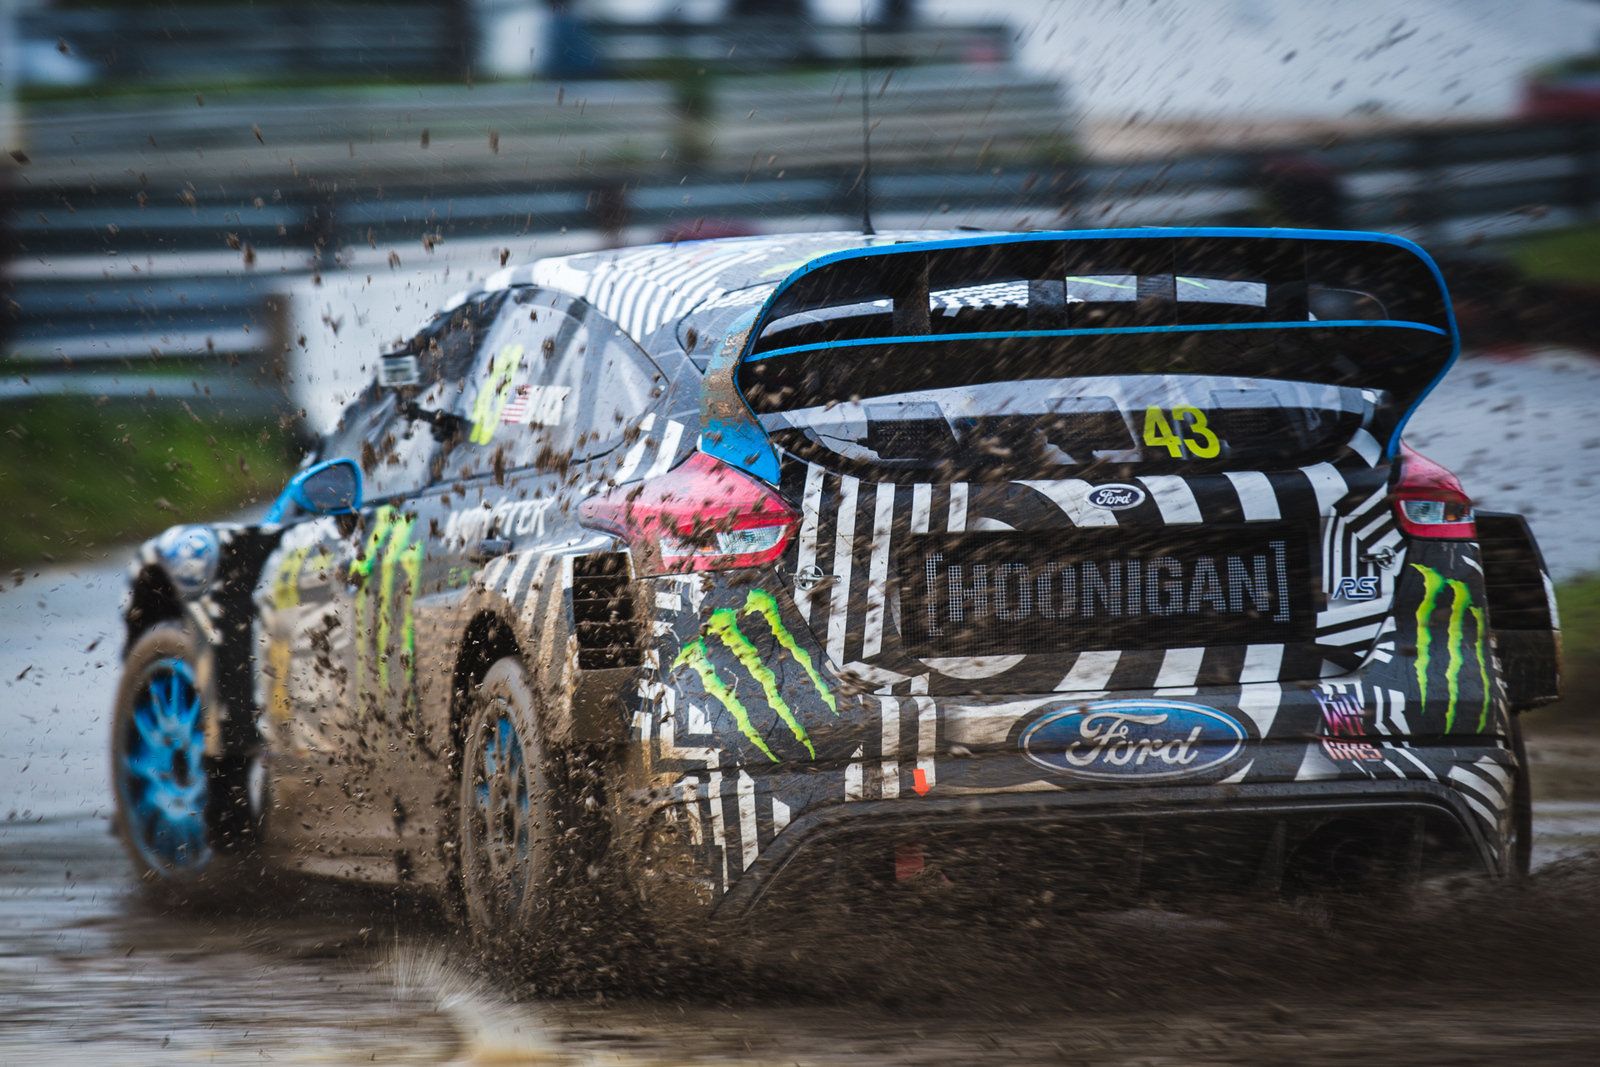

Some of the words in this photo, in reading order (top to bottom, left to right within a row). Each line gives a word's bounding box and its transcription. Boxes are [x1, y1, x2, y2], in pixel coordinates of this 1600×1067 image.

[1143, 404, 1221, 459] 43
[1095, 488, 1133, 505] Ford
[1331, 576, 1379, 600] RS
[1065, 712, 1203, 767] Ford
